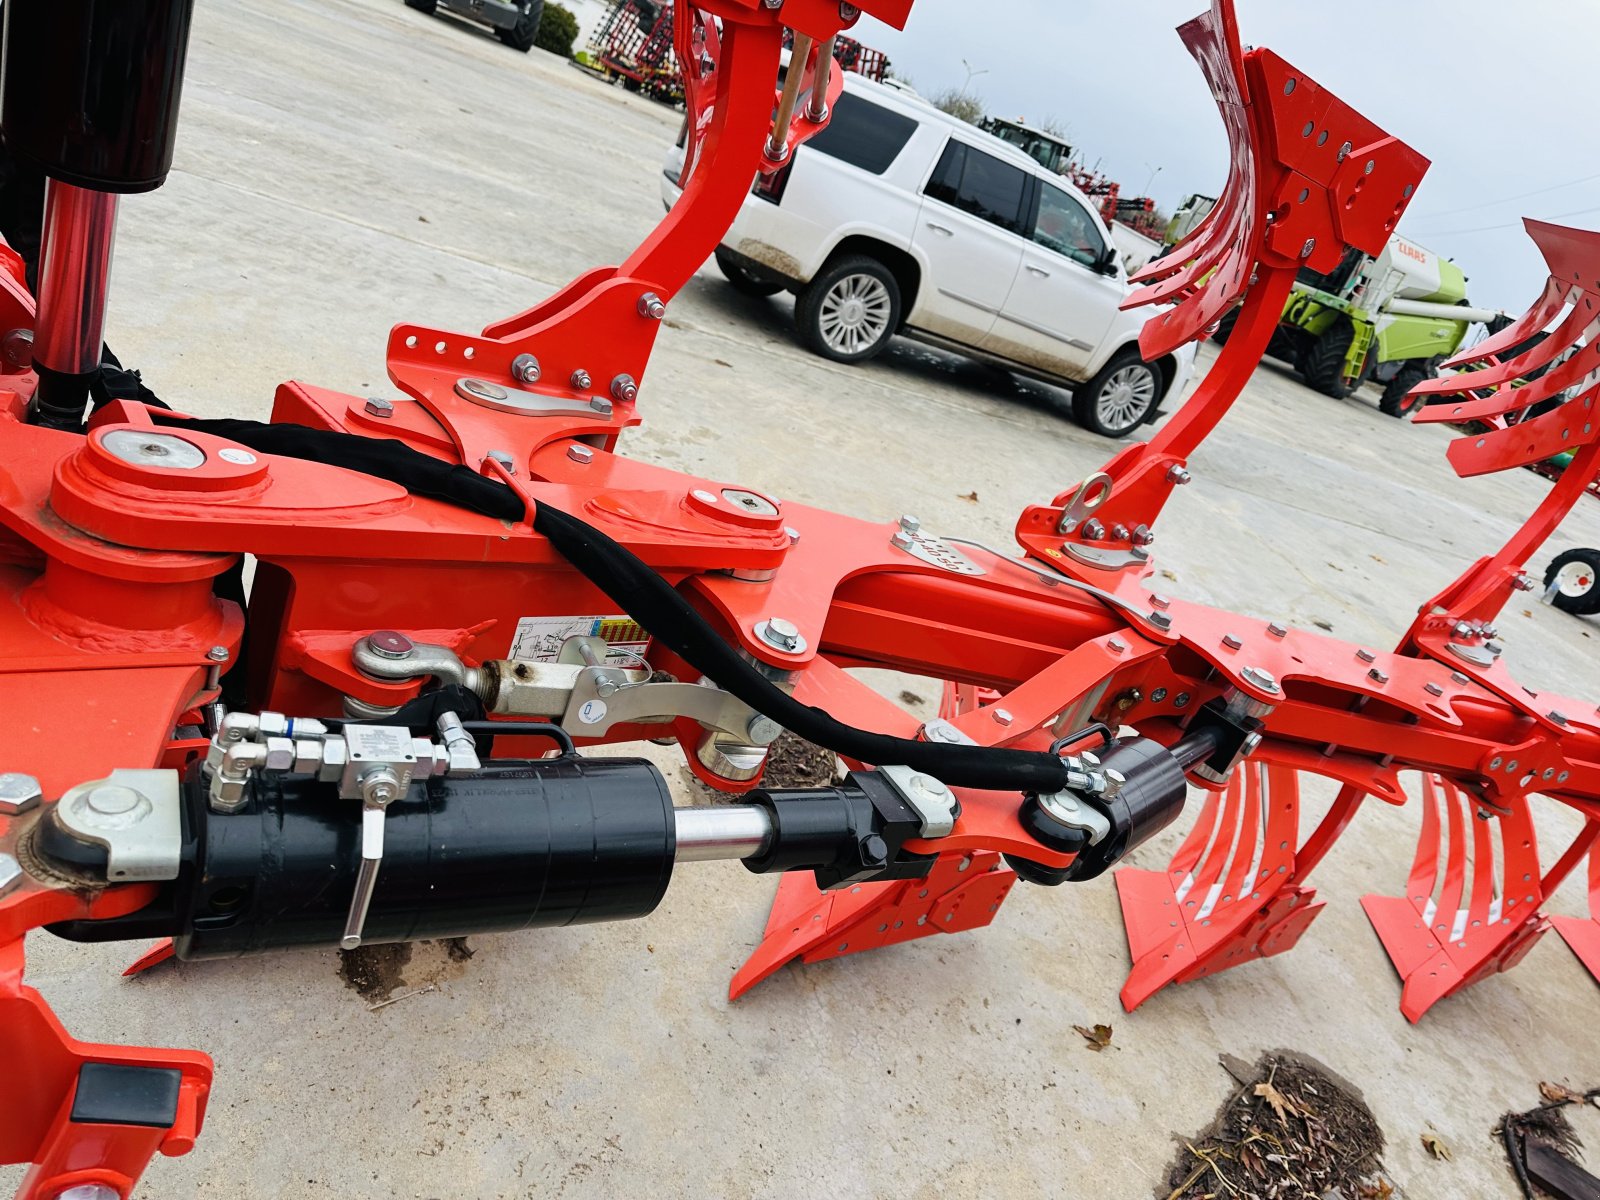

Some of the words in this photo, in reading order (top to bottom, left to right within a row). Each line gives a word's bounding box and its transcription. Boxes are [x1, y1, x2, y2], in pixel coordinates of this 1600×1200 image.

[1399, 242, 1425, 264] CLAAS
[921, 544, 941, 556] 40
[936, 557, 960, 570] 50
